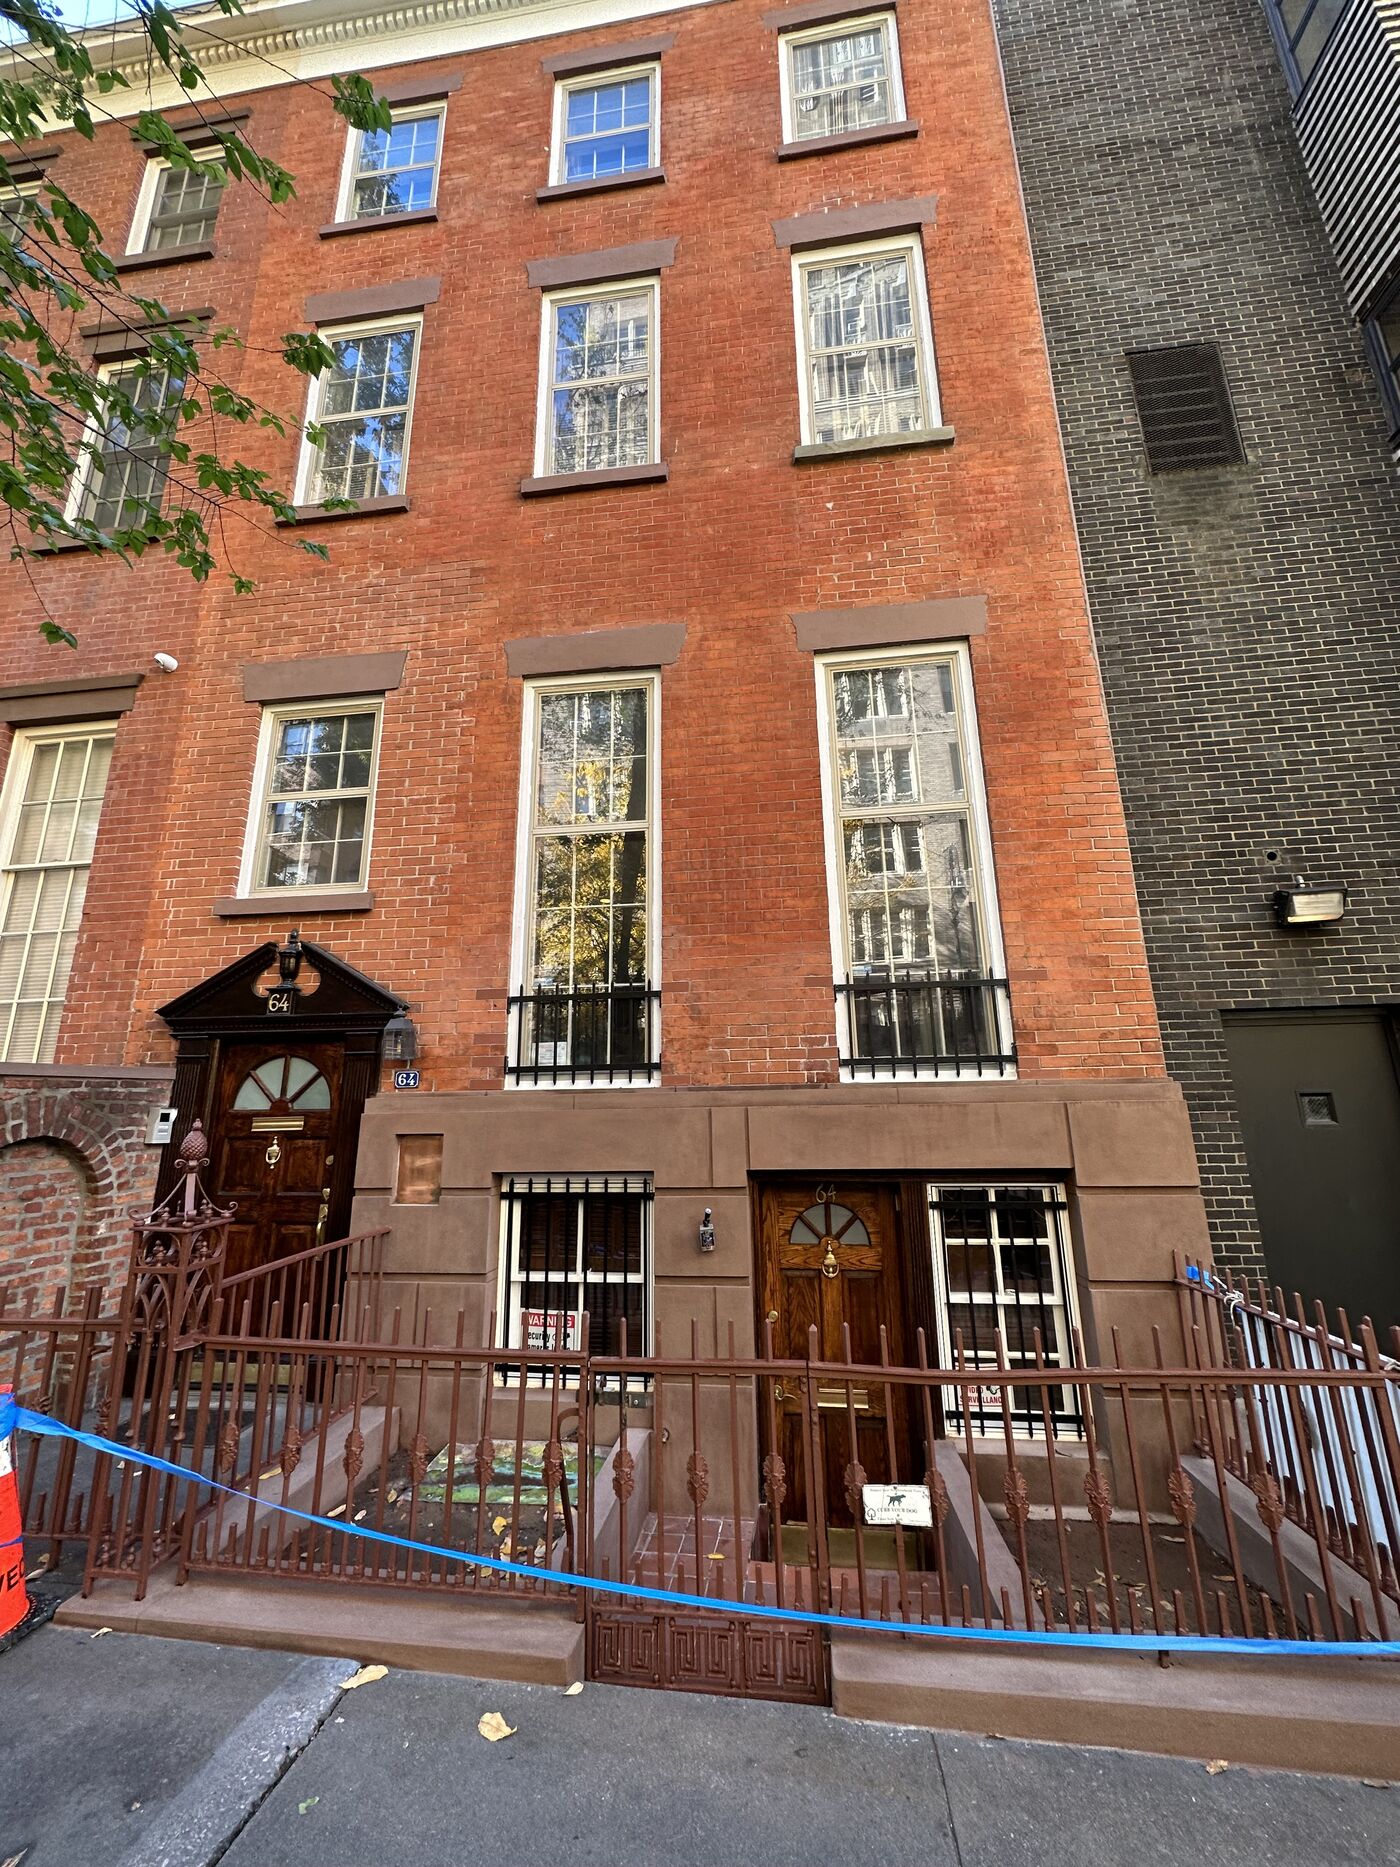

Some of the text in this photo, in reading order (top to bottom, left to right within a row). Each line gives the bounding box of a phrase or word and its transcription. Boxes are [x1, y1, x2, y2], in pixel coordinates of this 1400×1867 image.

[269, 993, 289, 1012] 64
[398, 1073, 415, 1086] 64
[815, 1183, 837, 1203] 64
[526, 1314, 572, 1327] WARNIG
